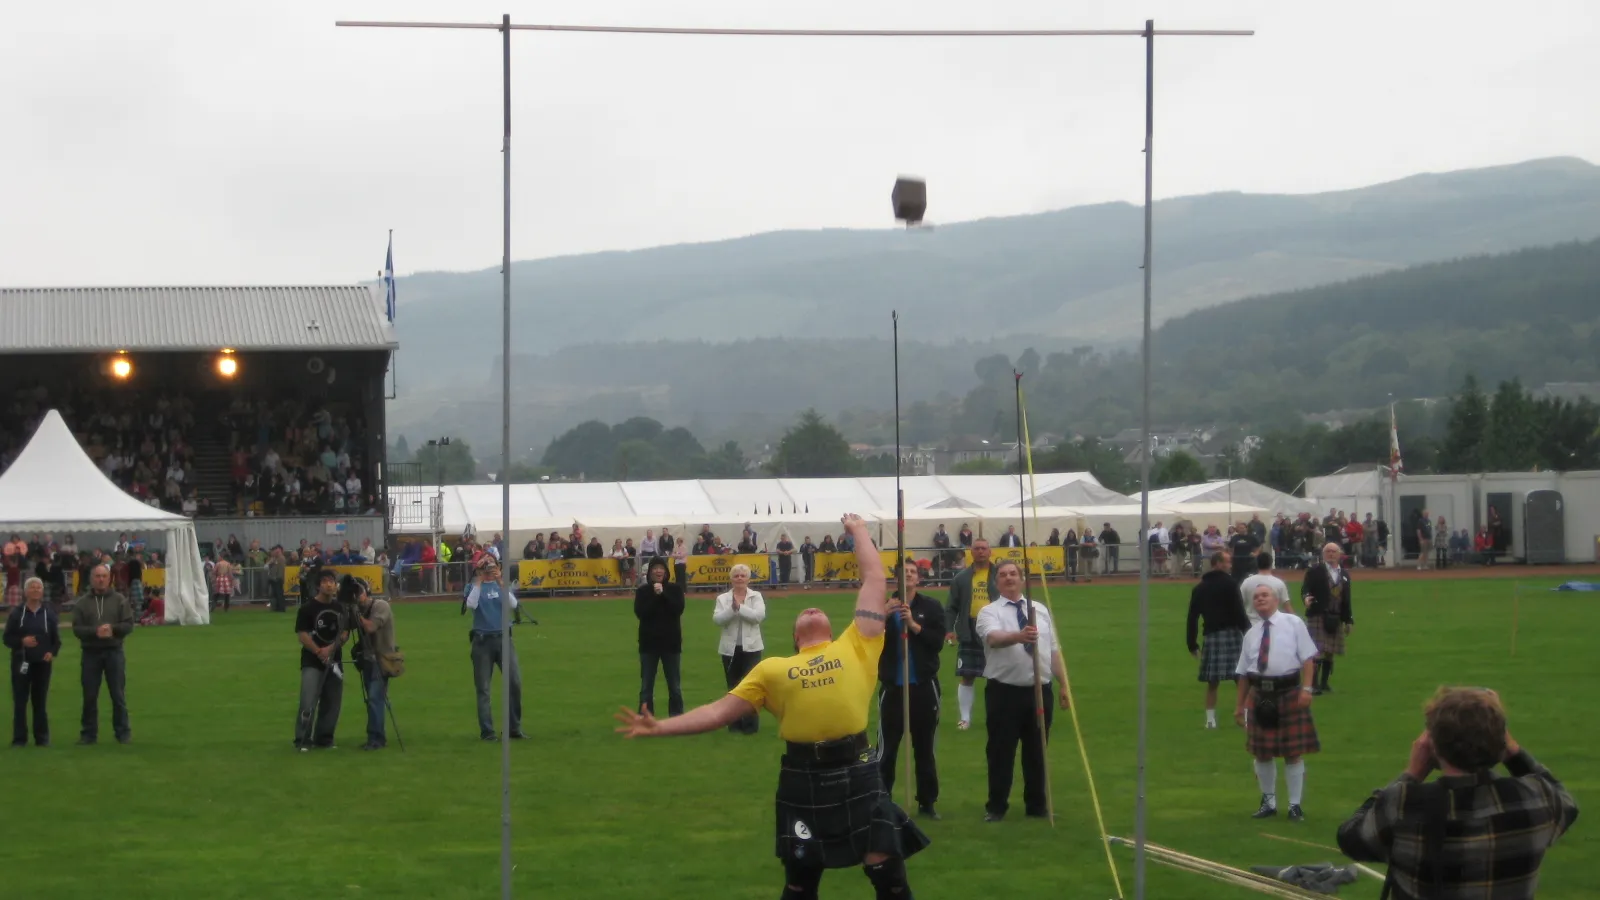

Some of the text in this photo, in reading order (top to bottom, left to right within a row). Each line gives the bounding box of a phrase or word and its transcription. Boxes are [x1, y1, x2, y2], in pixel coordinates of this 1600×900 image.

[548, 567, 588, 579] Corona
[699, 564, 731, 575] Coron
[788, 658, 842, 680] Corona
[801, 676, 835, 689] Extra
[800, 824, 808, 835] 2
